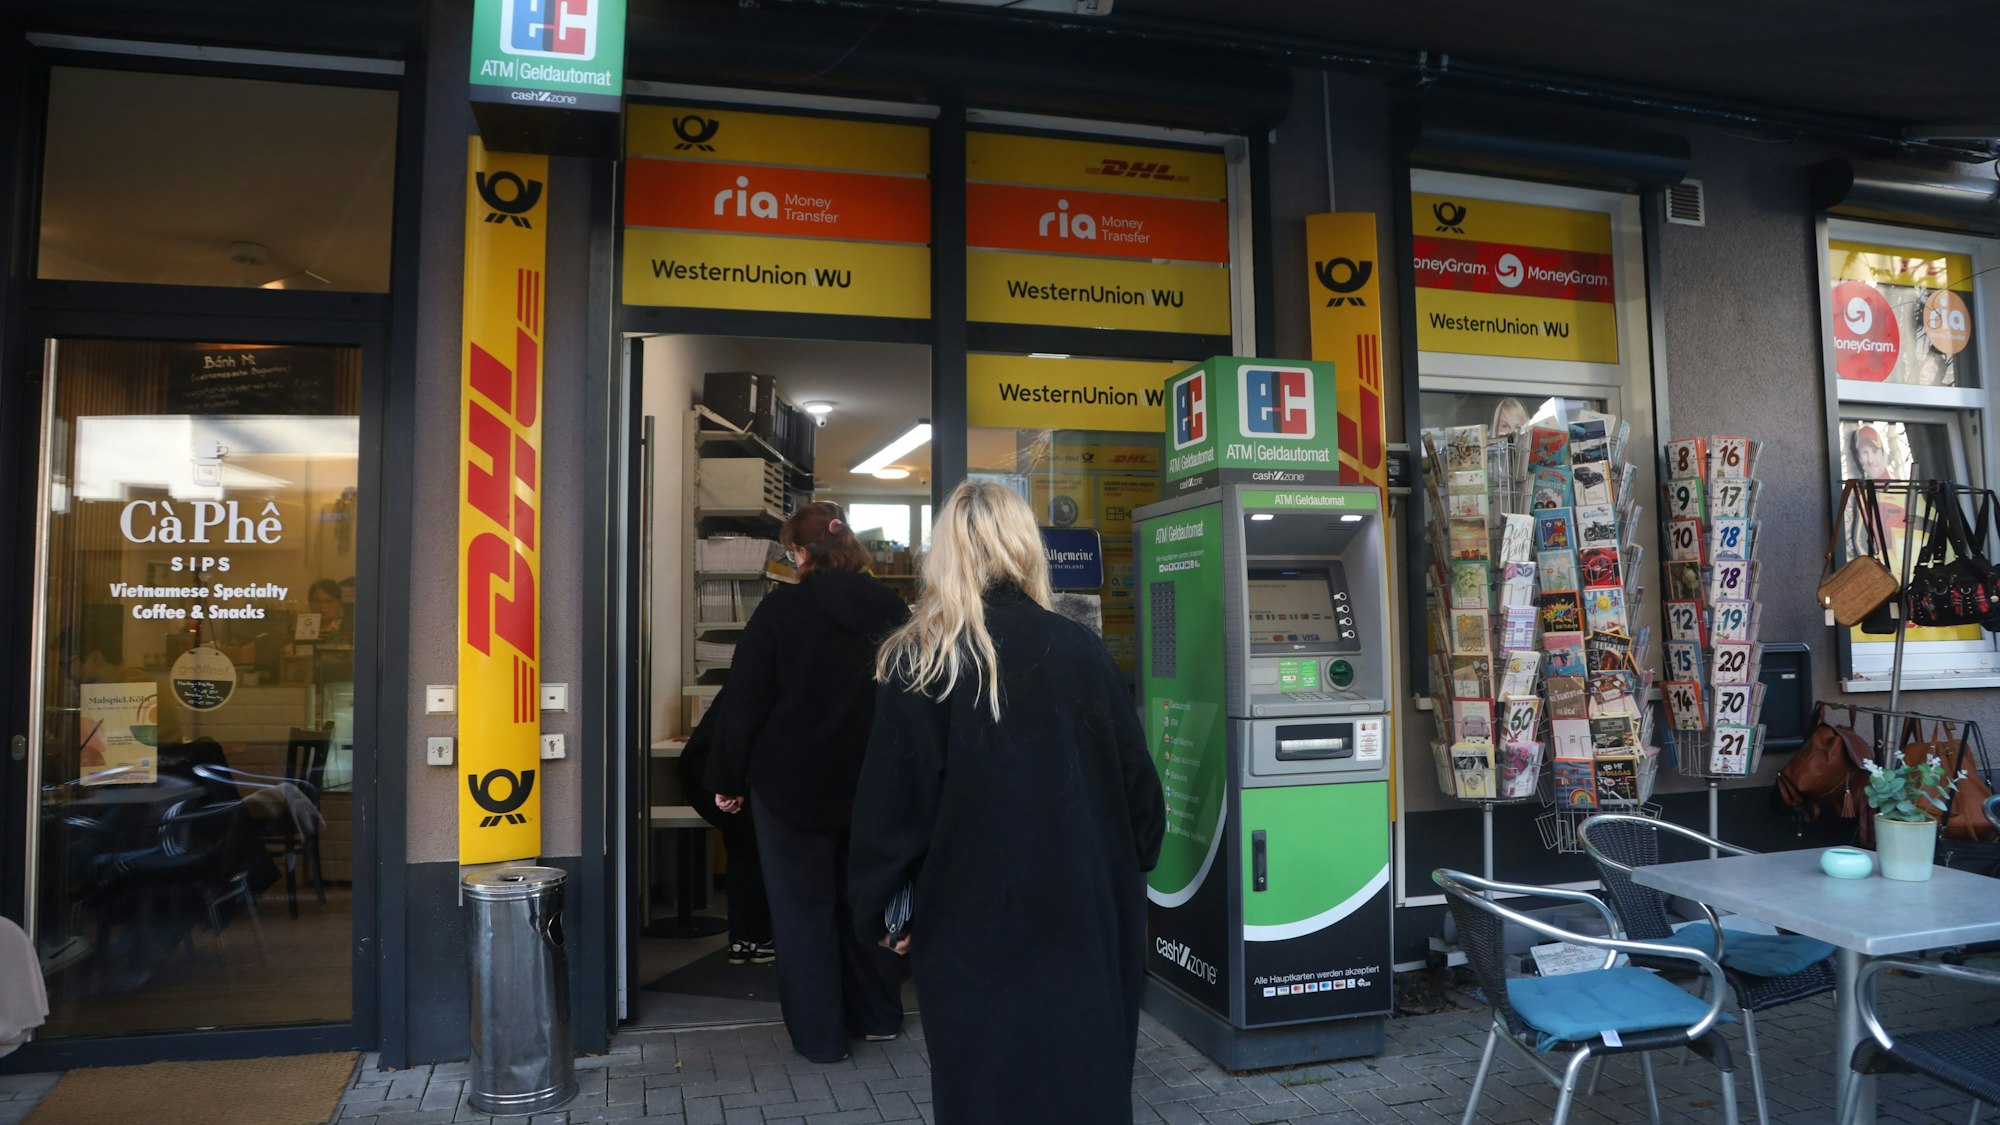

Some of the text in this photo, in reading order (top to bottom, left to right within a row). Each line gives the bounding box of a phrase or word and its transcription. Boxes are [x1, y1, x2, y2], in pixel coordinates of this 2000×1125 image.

[481, 60, 611, 86] ATM Geldautomat
[1101, 159, 1176, 181] DHL
[714, 176, 778, 218] ria
[785, 193, 831, 210] Money
[784, 208, 839, 223] Transfer
[1039, 199, 1096, 239] ria
[1102, 216, 1143, 231] Money
[1102, 230, 1149, 243] Transfer
[652, 259, 806, 285] WesternUnion
[1414, 258, 1607, 286] oneyGram MoneyGram
[1007, 280, 1144, 305] WesternUnion
[1430, 312, 1538, 336] WesternUnion
[1930, 298, 1966, 331] ria
[999, 383, 1164, 407] WesternUnion W
[1169, 446, 1214, 474] ATM Geldautomat
[1226, 444, 1330, 463] ATM Geldautomat
[1678, 446, 1689, 471] 8
[1720, 445, 1740, 467] 16
[467, 327, 538, 662] DHL
[1274, 494, 1345, 506] ATM Geldautomat
[1677, 486, 1690, 511] 9
[1720, 486, 1742, 507] 17
[120, 500, 282, 544] Cà Phê
[1155, 520, 1204, 545] ATM Geldautomat
[1673, 527, 1692, 549] 10
[1720, 526, 1740, 548] 18
[171, 557, 231, 572] SIPS
[1720, 567, 1741, 589] 18
[109, 583, 288, 601] Vietnamese Specialty
[132, 604, 265, 620] Coffee & Snacks
[1673, 609, 1693, 630] 12
[1722, 608, 1743, 631] 19
[1674, 650, 1692, 672] 15
[1718, 651, 1745, 672] 20
[1673, 690, 1693, 712] 14
[1511, 707, 1534, 731] 60
[1718, 735, 1745, 756] 21
[1254, 965, 1380, 985] Alle Hauptkarten werden akzeptiert
